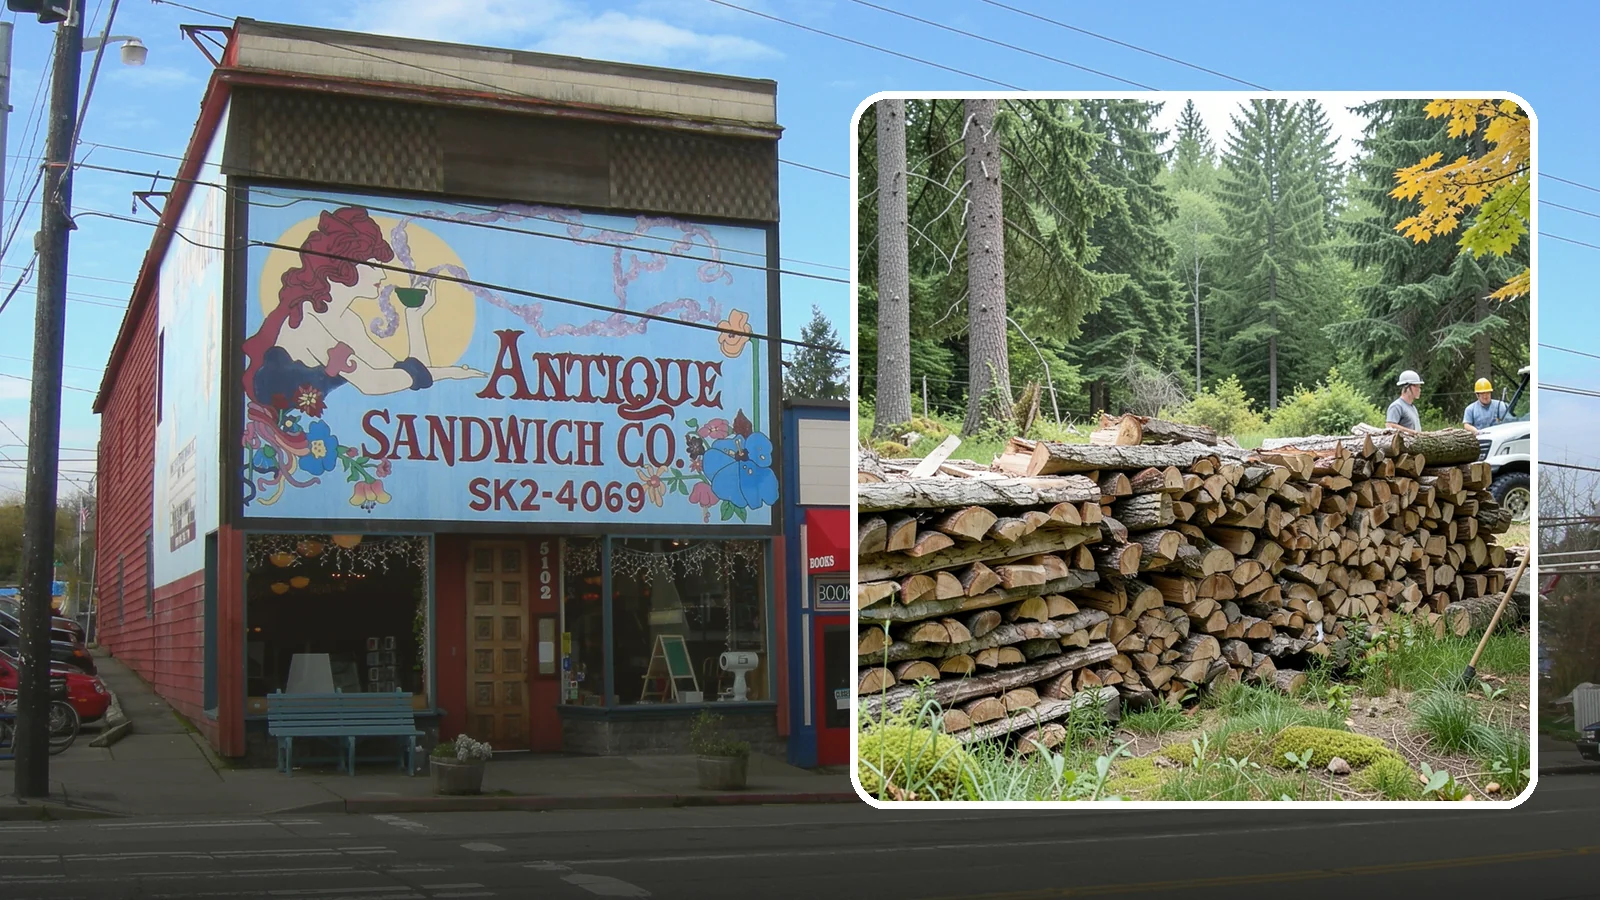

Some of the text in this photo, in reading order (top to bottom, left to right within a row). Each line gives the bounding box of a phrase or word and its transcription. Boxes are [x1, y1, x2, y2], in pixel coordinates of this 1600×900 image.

[476, 329, 723, 421] ANTIQUE
[361, 408, 685, 469] SANDWICH CO.
[468, 477, 646, 513] SK2-4069
[539, 541, 552, 600] 5102
[809, 555, 835, 569] BOOKS
